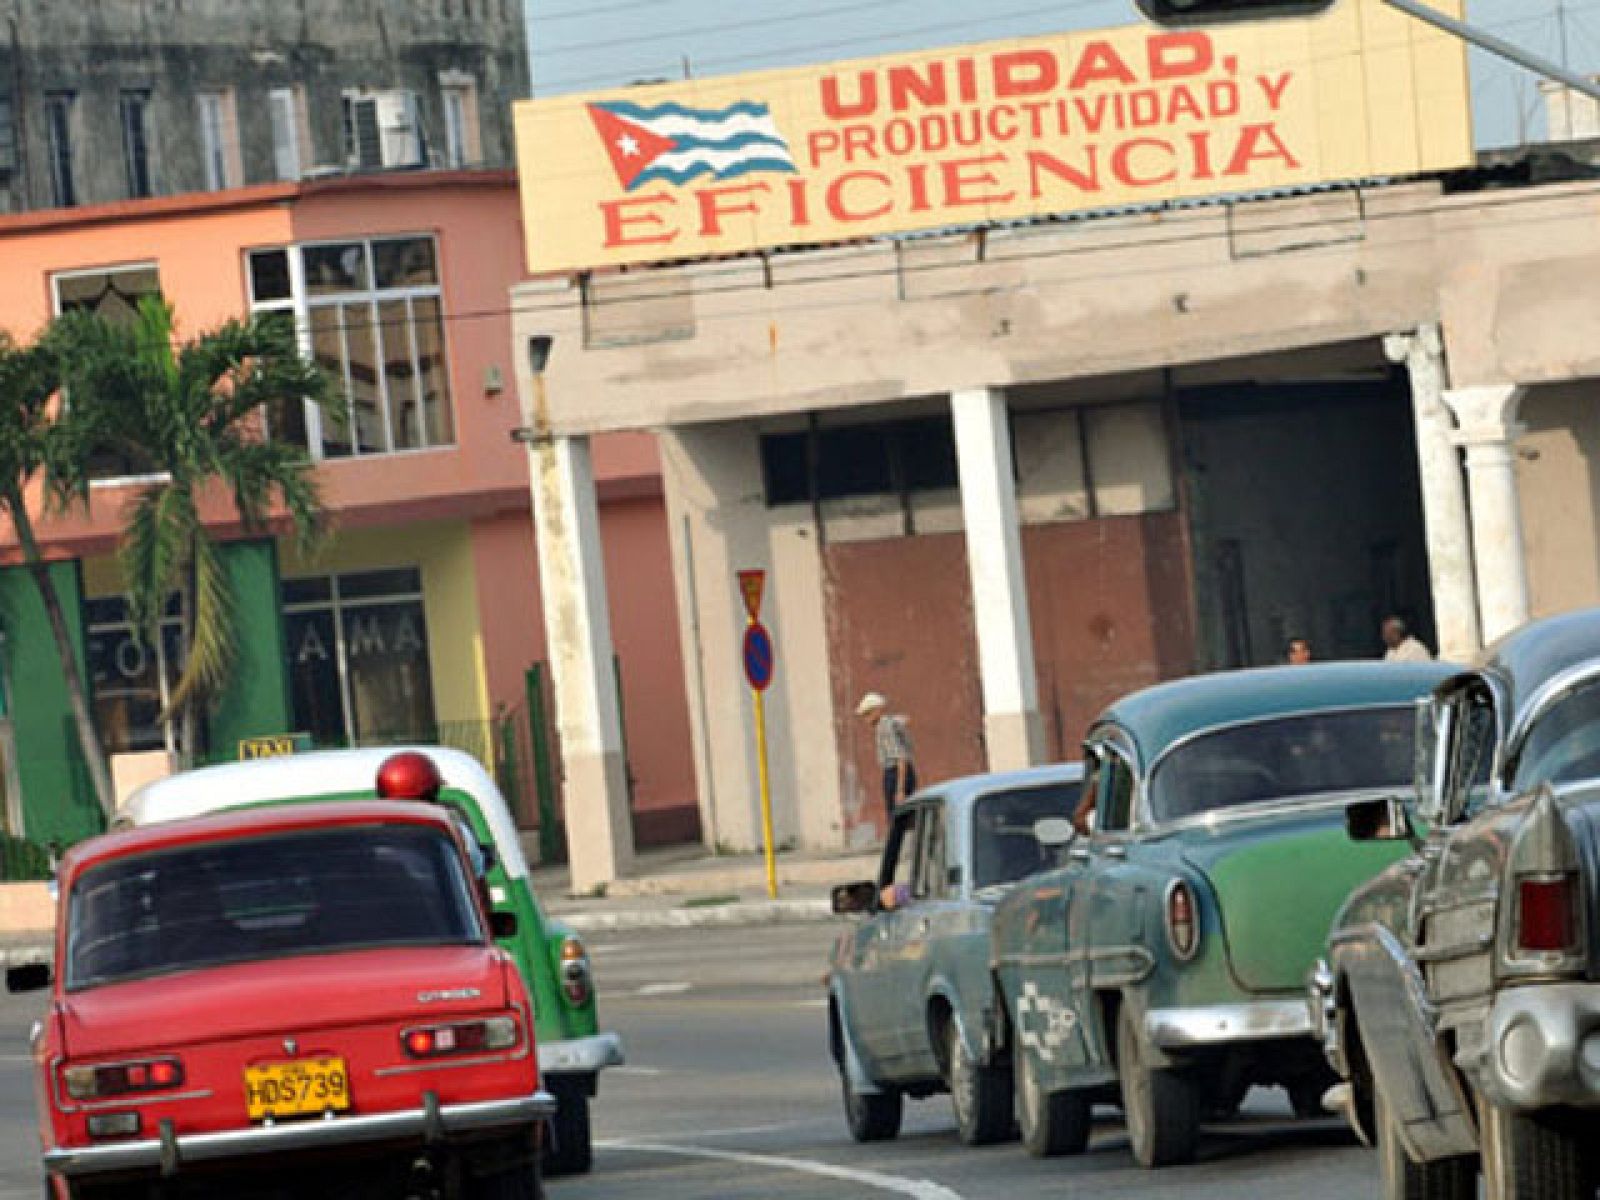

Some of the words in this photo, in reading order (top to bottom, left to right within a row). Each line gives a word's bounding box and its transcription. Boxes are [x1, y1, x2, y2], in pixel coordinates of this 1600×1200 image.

[807, 79, 1241, 168] PRODUCTIVIDAD
[1256, 71, 1293, 111] Y
[819, 30, 1238, 120] UNIDAD,
[597, 122, 1302, 248] EFICIENCIA
